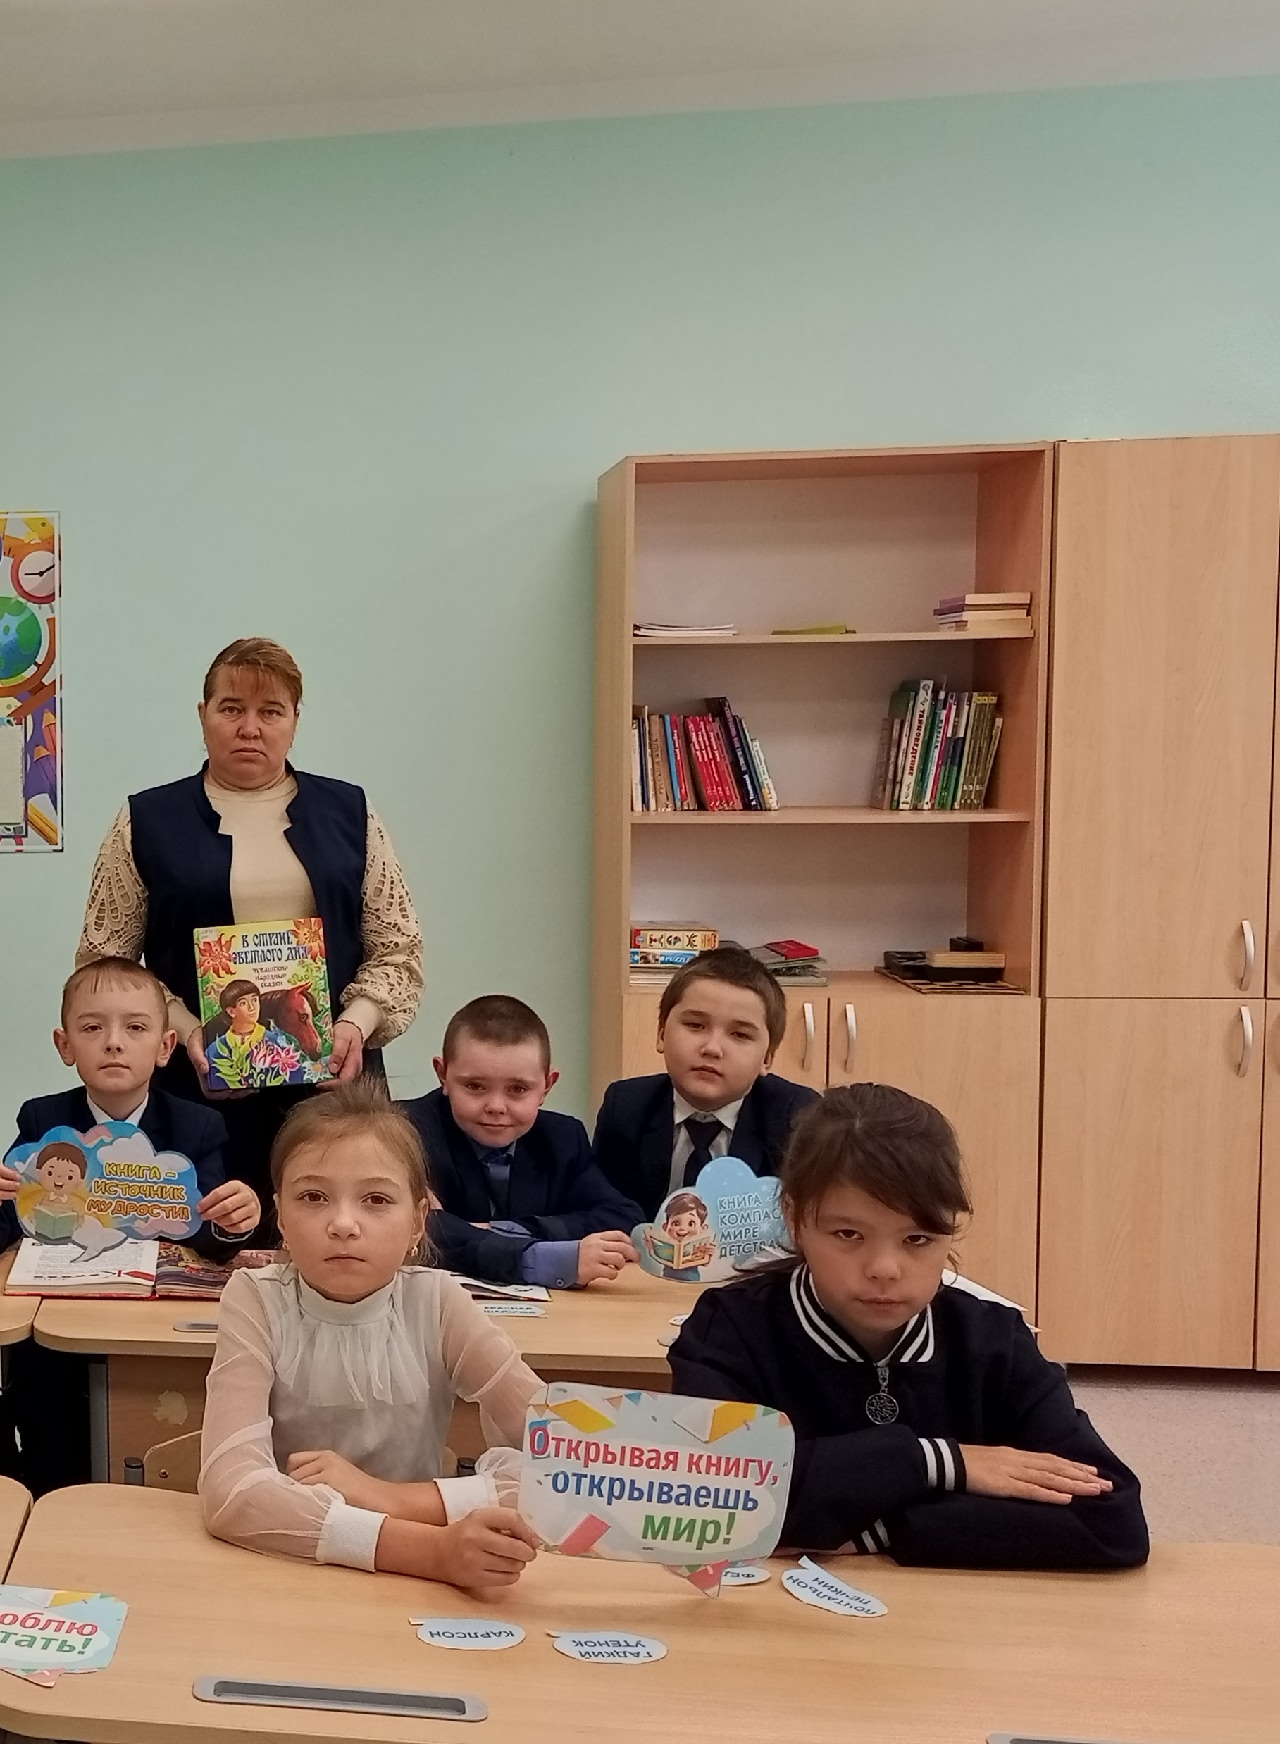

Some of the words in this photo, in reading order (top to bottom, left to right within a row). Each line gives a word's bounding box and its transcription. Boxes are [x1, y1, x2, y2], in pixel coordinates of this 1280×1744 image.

[242, 934, 250, 948] В
[252, 931, 293, 947] СТРАНЕ
[285, 946, 308, 962] ДНЯ
[105, 1162, 161, 1180] КНИГА
[93, 1179, 186, 1201] ИСТОЧНИК
[86, 1200, 190, 1220] МУДРОСТИ!
[718, 1193, 762, 1210] КНИГА
[719, 1208, 781, 1227] КОМПАС
[719, 1226, 759, 1243] МИРЕ
[529, 1426, 679, 1468] Открывая
[687, 1452, 779, 1486] книгу,
[551, 1470, 759, 1511] открываешь
[641, 1512, 736, 1550] мир!
[786, 1575, 877, 1615] ПОЧТАЛЬОН
[812, 1576, 872, 1605] ПЕЧКИН
[429, 1630, 515, 1639] КАРЛСОН
[572, 1639, 646, 1648] УТЕНОК
[578, 1650, 653, 1660] ГАДКИЙ
